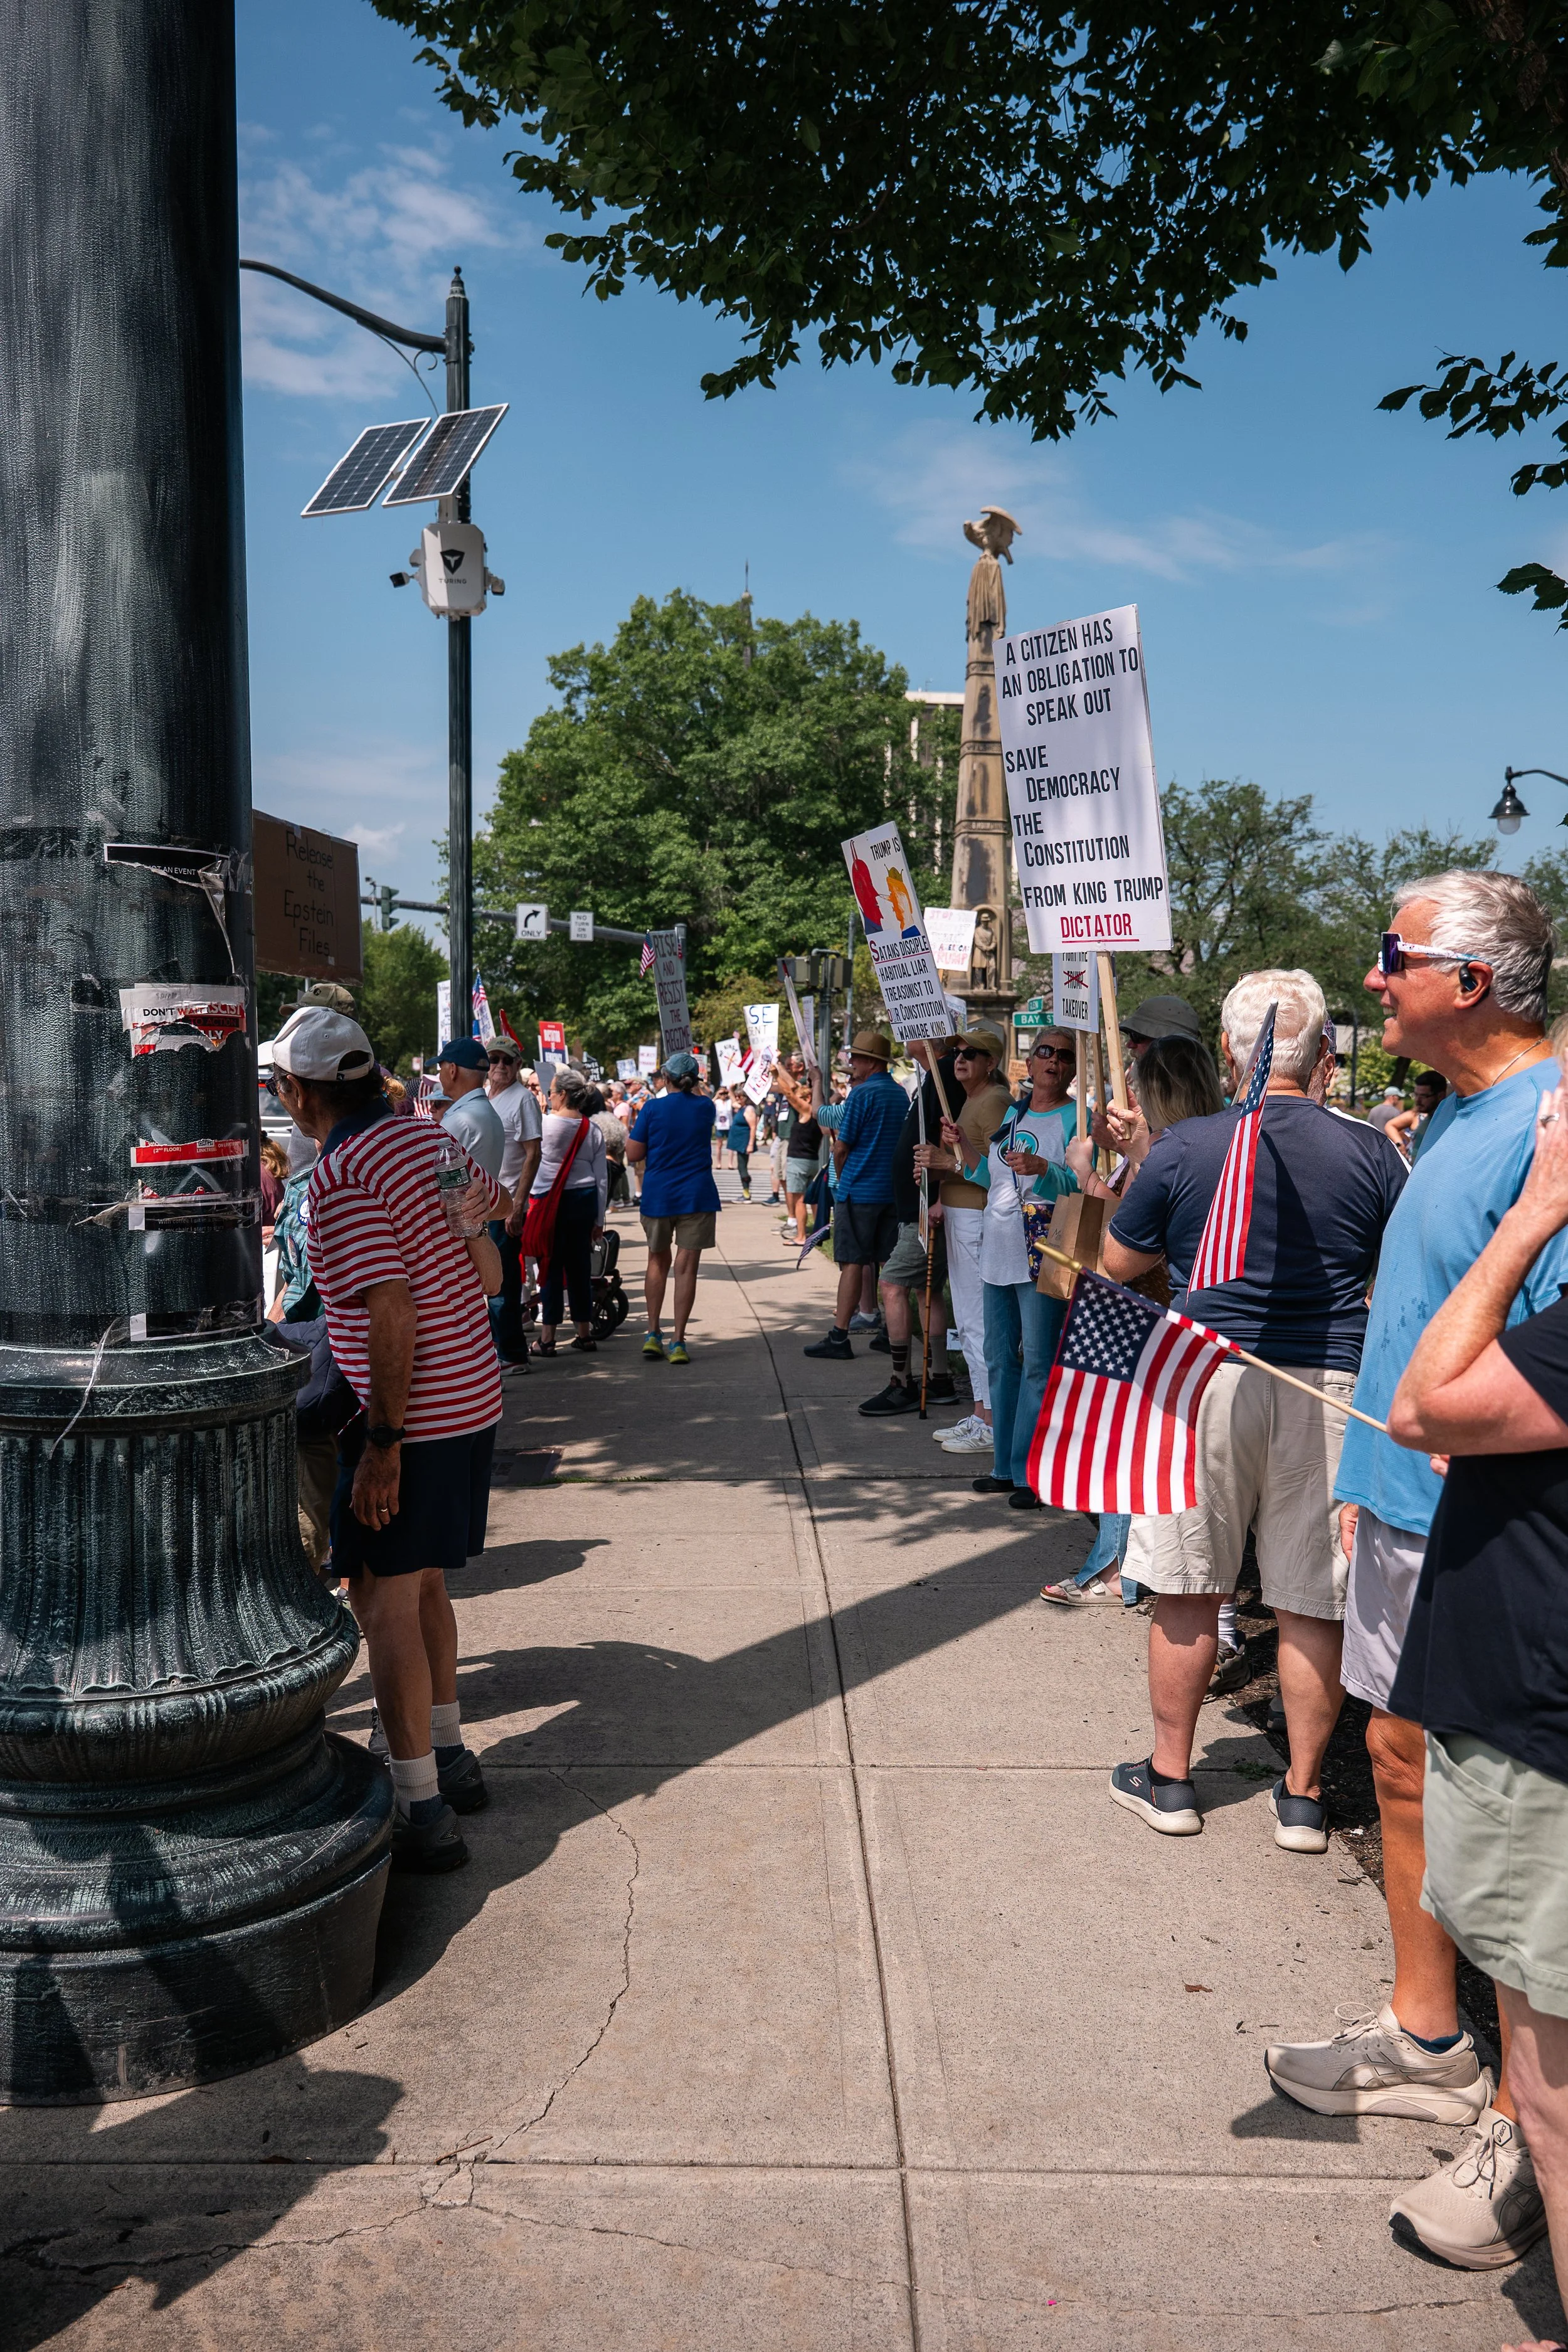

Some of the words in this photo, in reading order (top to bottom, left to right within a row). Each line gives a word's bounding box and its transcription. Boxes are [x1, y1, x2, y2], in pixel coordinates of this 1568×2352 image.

[1006, 642, 1017, 665] A
[1020, 630, 1078, 662] CITIZEN
[1083, 618, 1113, 647] HAS
[1002, 675, 1022, 699] AN
[1027, 650, 1115, 692] OBLIGATION
[1119, 647, 1138, 672] TO
[1026, 694, 1079, 726] SPEAK
[1083, 687, 1112, 714] OUT
[1005, 744, 1049, 773] SAVE
[1025, 766, 1120, 803] DEMOCRACY
[1014, 812, 1044, 837] THE
[286, 830, 334, 869] Release
[870, 840, 891, 861] TRUMP
[893, 837, 901, 852] IS
[1023, 835, 1130, 867] CONSTITUTION
[307, 869, 325, 892] the
[1023, 884, 1067, 908] FROM
[1074, 881, 1107, 905] KING
[1114, 877, 1163, 902] TRUMP
[284, 889, 334, 928] Epstein
[930, 910, 953, 920] STOP
[1060, 913, 1133, 938] DICTATOR
[299, 927, 330, 956] Files
[653, 935, 677, 958] RISE
[869, 940, 900, 961] SATANS
[899, 936, 929, 956] DISCIPLE
[662, 960, 675, 976] AND
[879, 963, 911, 982] HABITUAL
[1067, 971, 1084, 989] TRUMP
[659, 980, 685, 1007] RESIST
[885, 982, 923, 1002] TREASONIST
[923, 980, 934, 995] TO
[143, 1008, 174, 1016] DON'T
[669, 1009, 682, 1024] THE
[887, 1007, 901, 1022] OUR
[1021, 1015, 1040, 1024] BAY
[1062, 999, 1088, 1020] TAKEOVER
[665, 1025, 692, 1054] REGIME
[898, 1023, 930, 1040] WANNABE
[930, 1020, 946, 1037] KING
